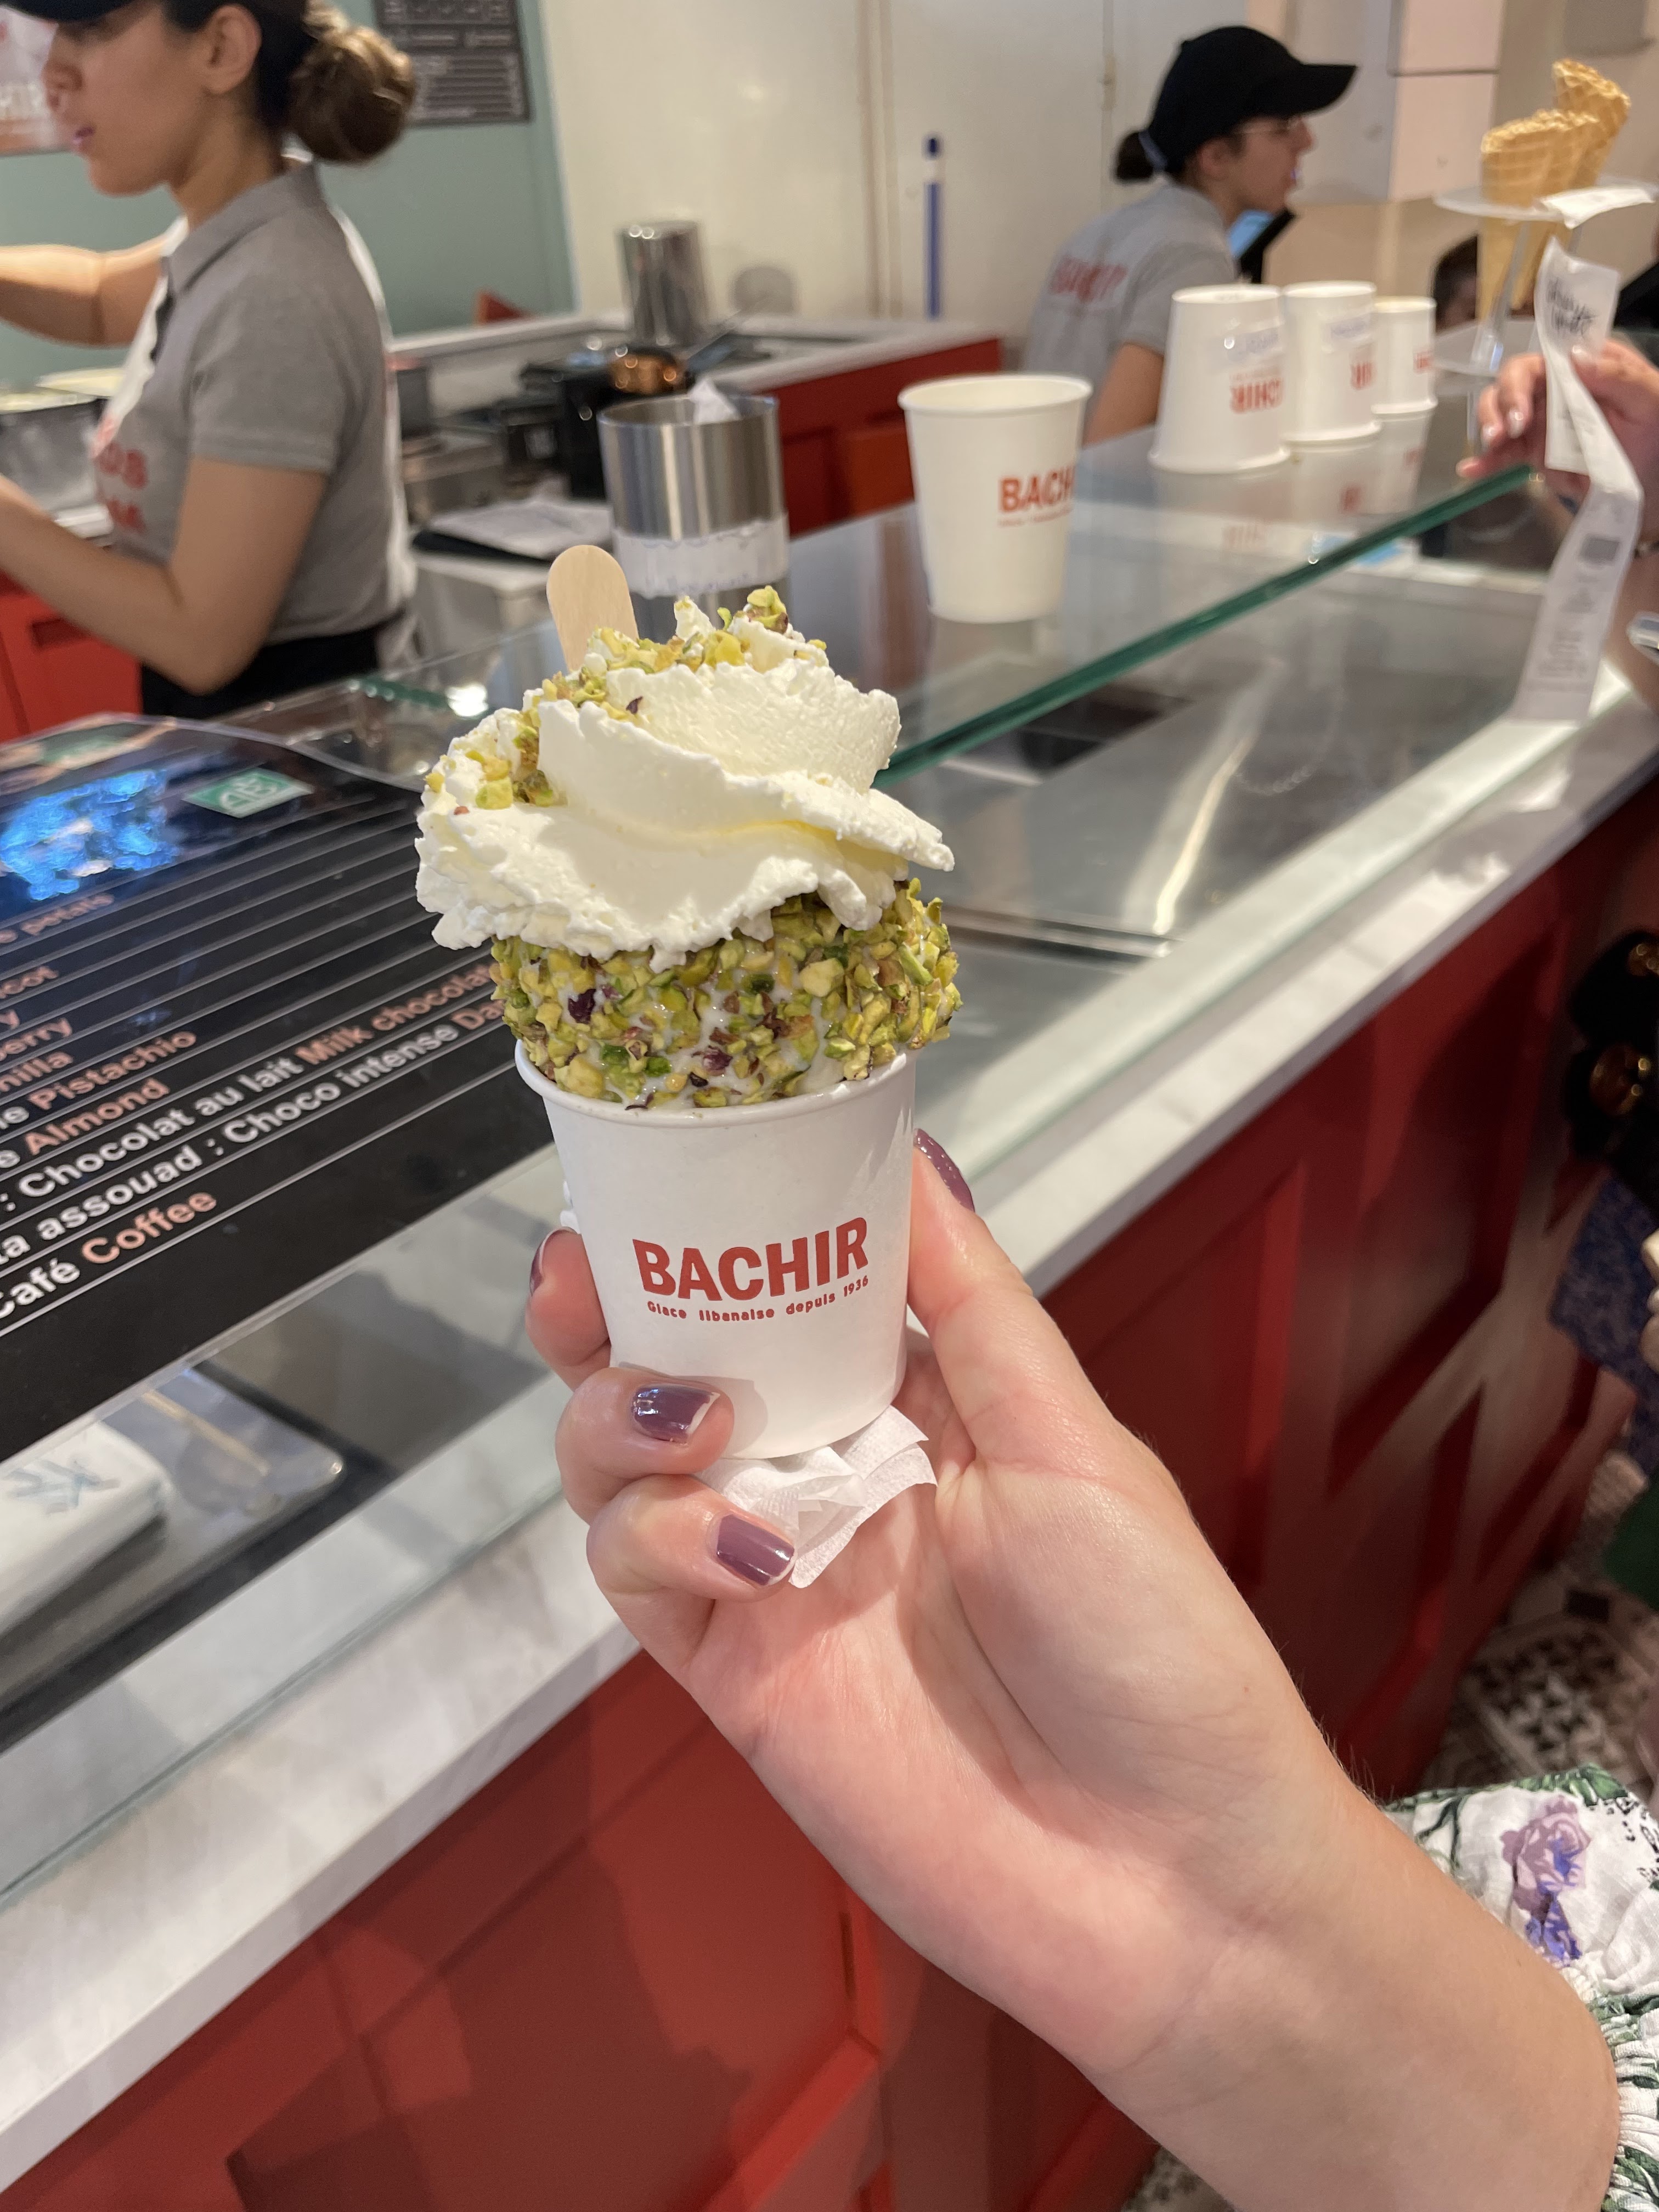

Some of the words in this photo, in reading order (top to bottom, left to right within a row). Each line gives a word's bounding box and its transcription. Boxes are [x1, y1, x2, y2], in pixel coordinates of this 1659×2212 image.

[0, 1051, 74, 1092] nilla
[28, 1030, 197, 1110] Pistachio
[19, 1108, 196, 1197] Chocolat
[194, 1086, 245, 1116] au
[236, 1057, 304, 1092] lait
[295, 1025, 375, 1065] Milk
[25, 1077, 171, 1155] Almond
[36, 1144, 203, 1240] assouad
[222, 1082, 341, 1143] Choco
[335, 1024, 460, 1088] intense
[82, 1192, 217, 1263] Coffee
[632, 1217, 869, 1301] BACHIR
[647, 1301, 687, 1319] Glace
[699, 1308, 775, 1322] libanaise
[786, 1293, 836, 1315] depuis
[843, 1274, 869, 1297] 1936
